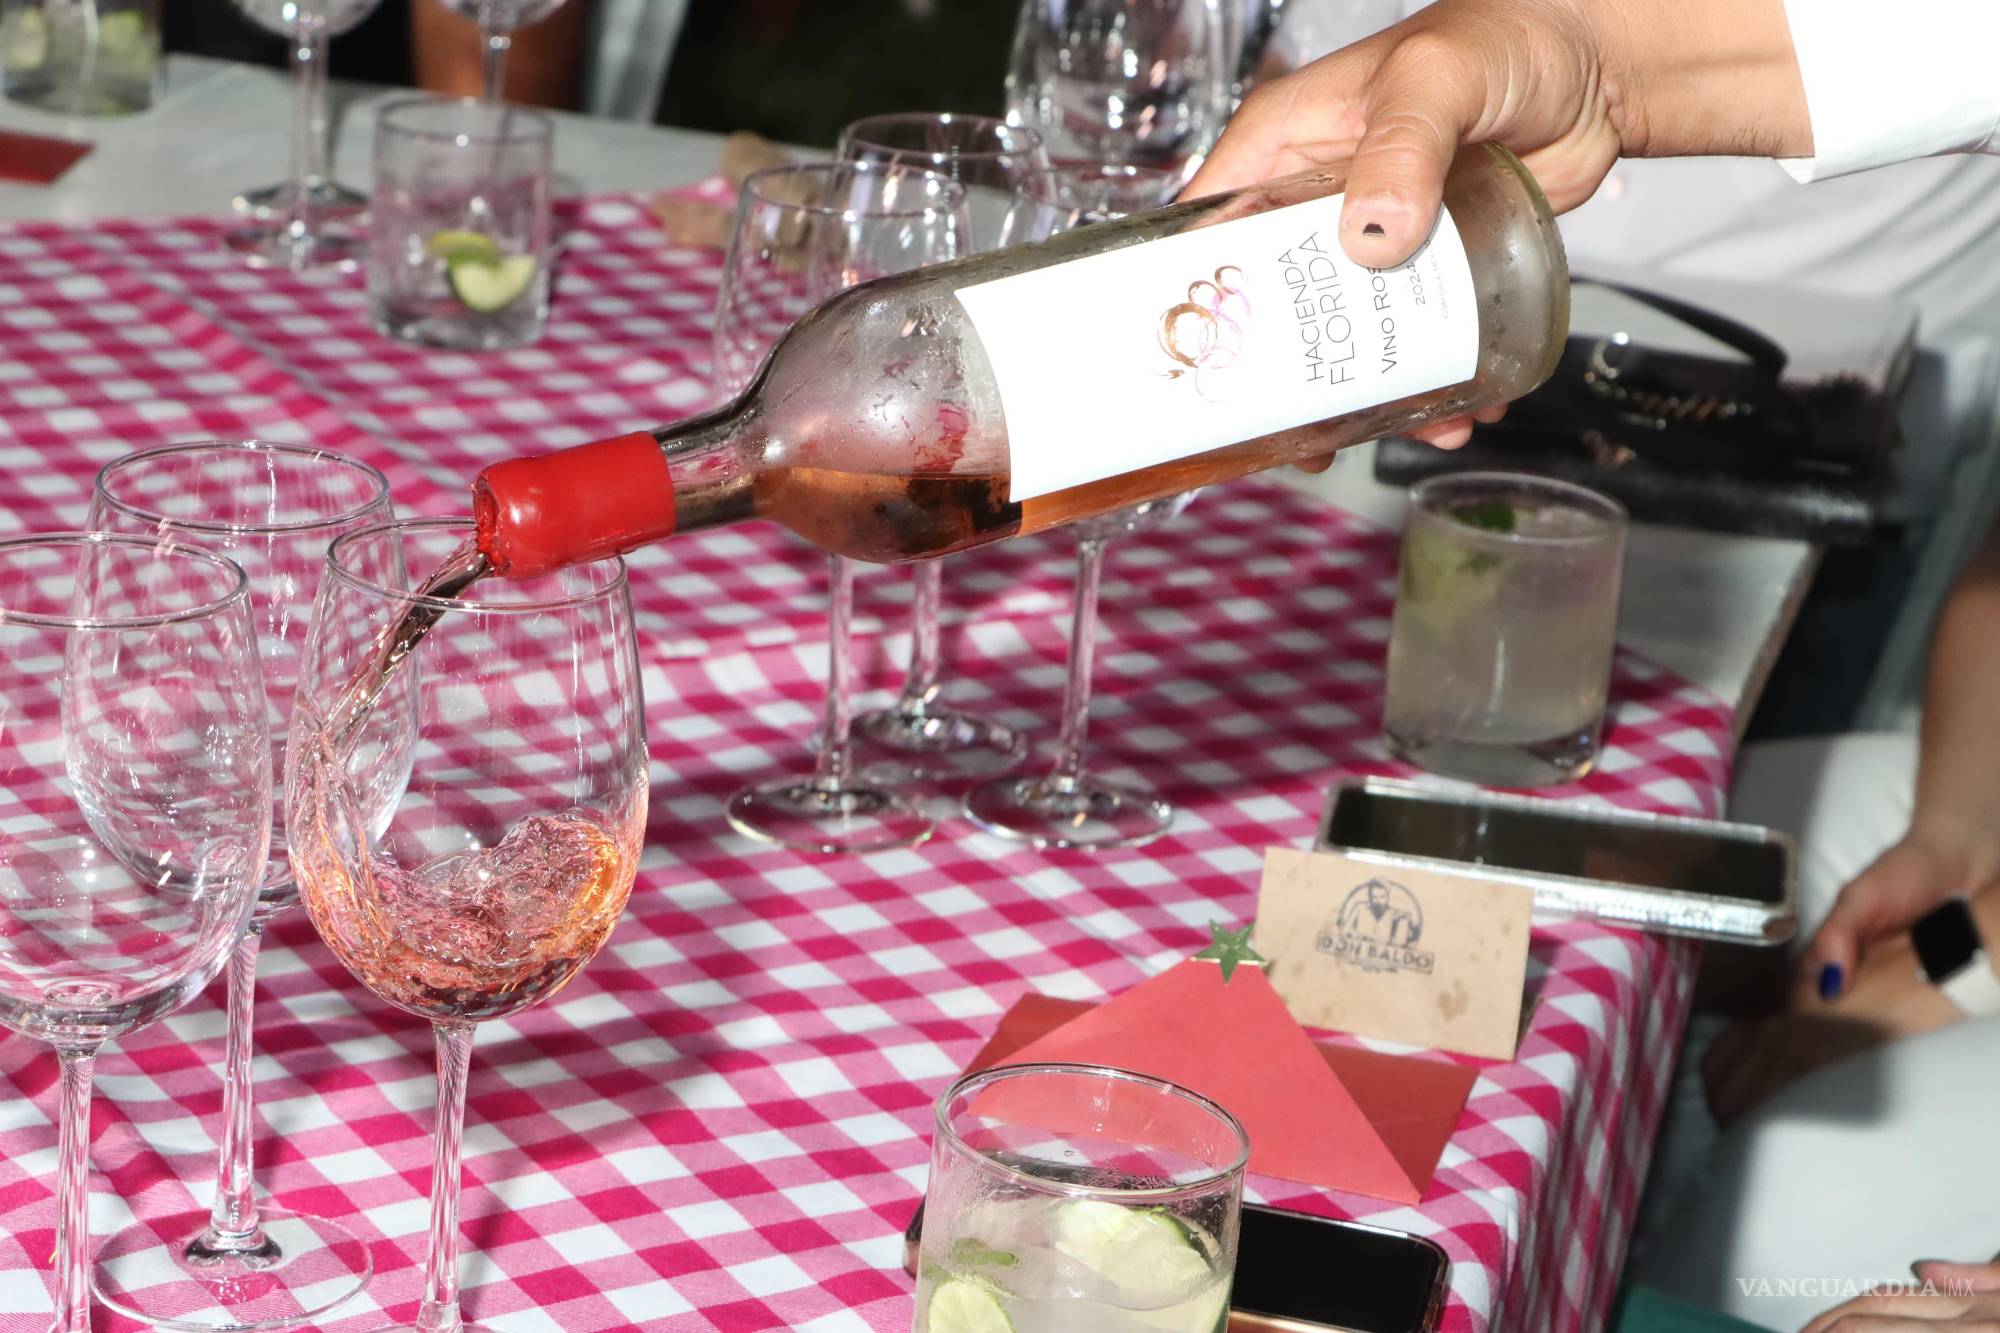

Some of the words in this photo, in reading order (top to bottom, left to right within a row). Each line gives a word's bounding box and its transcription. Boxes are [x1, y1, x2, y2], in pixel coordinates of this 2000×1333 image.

[1299, 231, 1356, 386] FLORIDA
[1367, 266, 1391, 311] ROS
[1406, 261, 1426, 306] 2024
[1278, 249, 1325, 382] HACIENDA
[1381, 317, 1397, 374] VINO
[1368, 946, 1432, 969] BALDO
